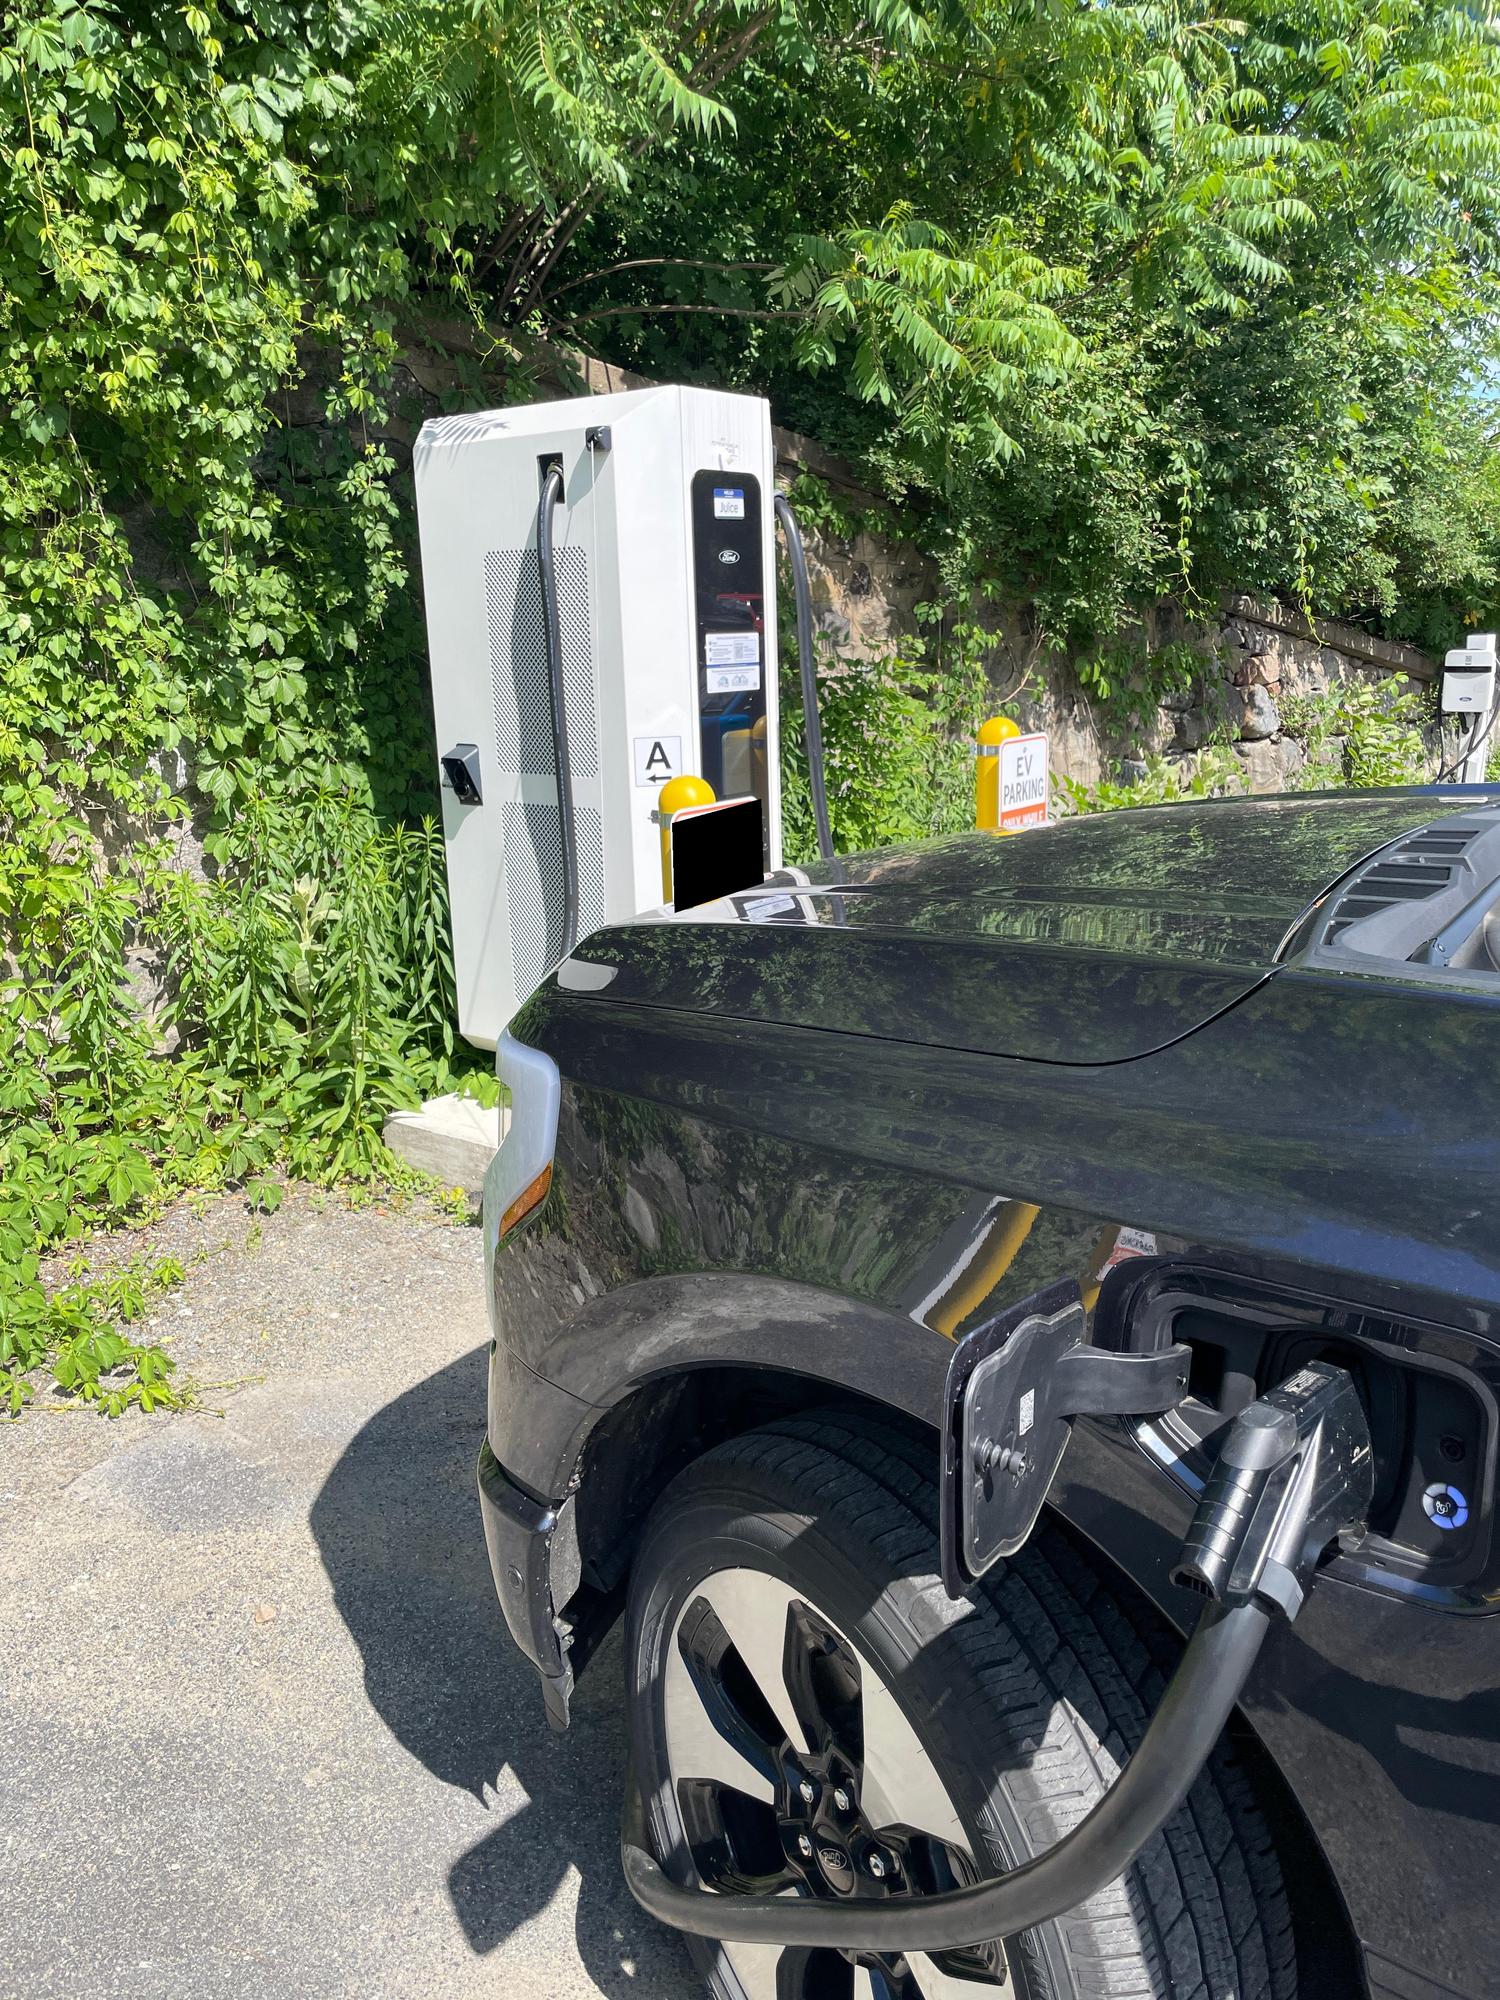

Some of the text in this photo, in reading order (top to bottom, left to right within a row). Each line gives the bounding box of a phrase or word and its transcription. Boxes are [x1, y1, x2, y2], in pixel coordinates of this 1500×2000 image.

[720, 501, 739, 514] Juice
[645, 741, 672, 770] A
[1016, 754, 1033, 777] EV
[1003, 778, 1045, 805] PARKING
